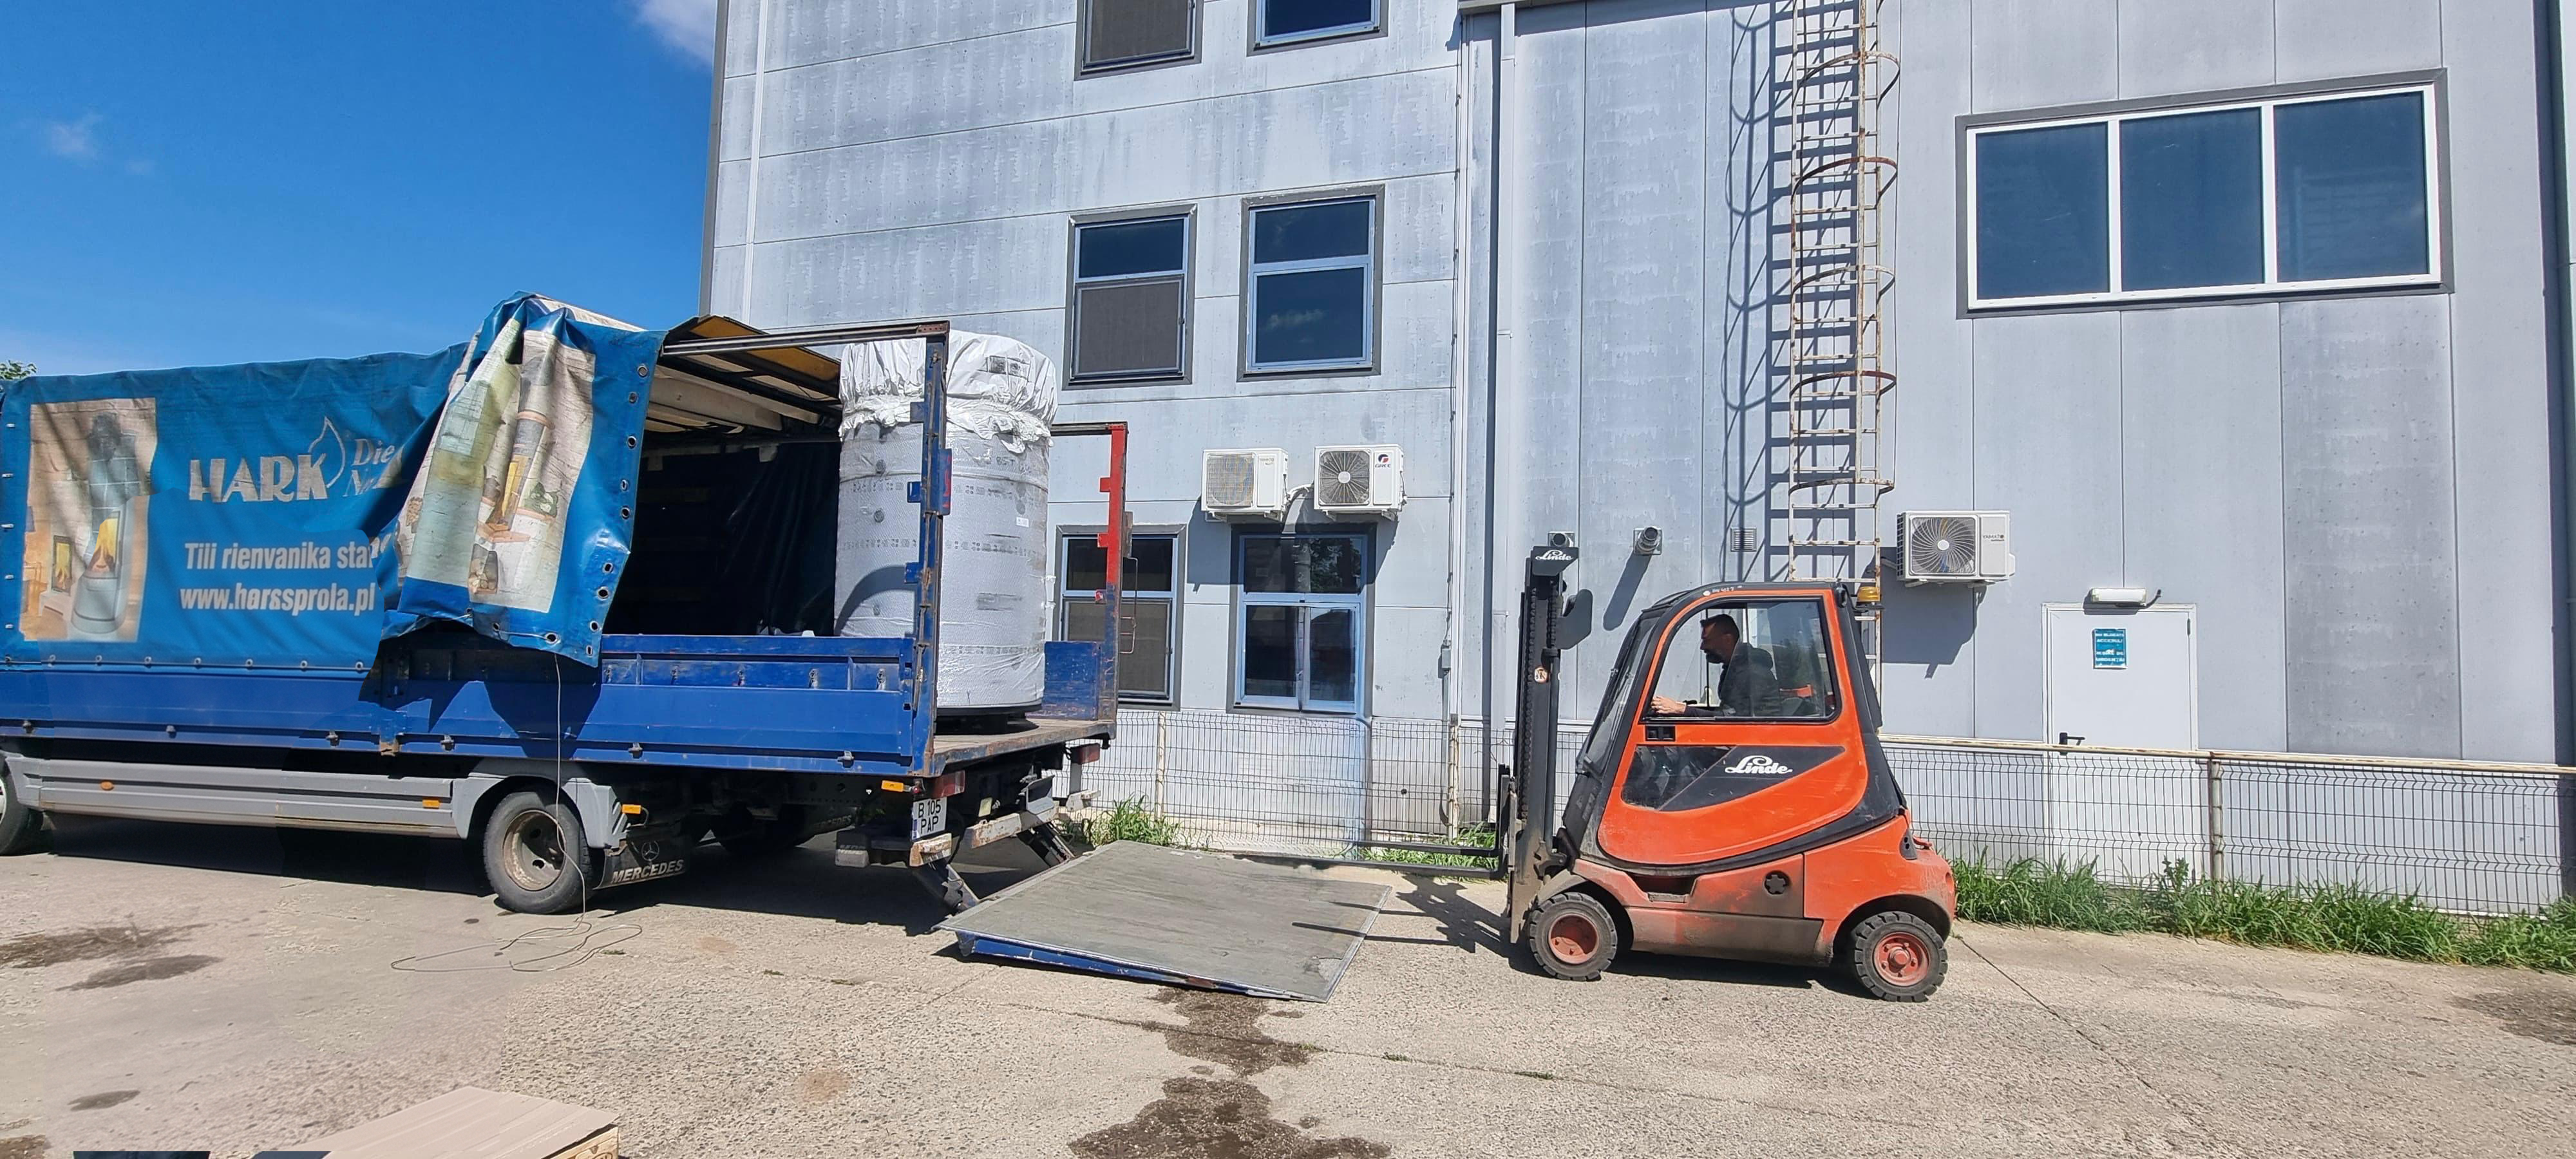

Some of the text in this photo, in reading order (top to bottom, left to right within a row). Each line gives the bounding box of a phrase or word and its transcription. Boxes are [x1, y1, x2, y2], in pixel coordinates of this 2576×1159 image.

[351, 438, 395, 466] Die
[189, 453, 328, 502] HARK
[1535, 549, 1573, 561] Linde
[1725, 755, 1793, 774] Linde
[918, 798, 942, 818] B 105
[920, 815, 939, 835] PAP
[611, 859, 685, 884] MERCEDES
